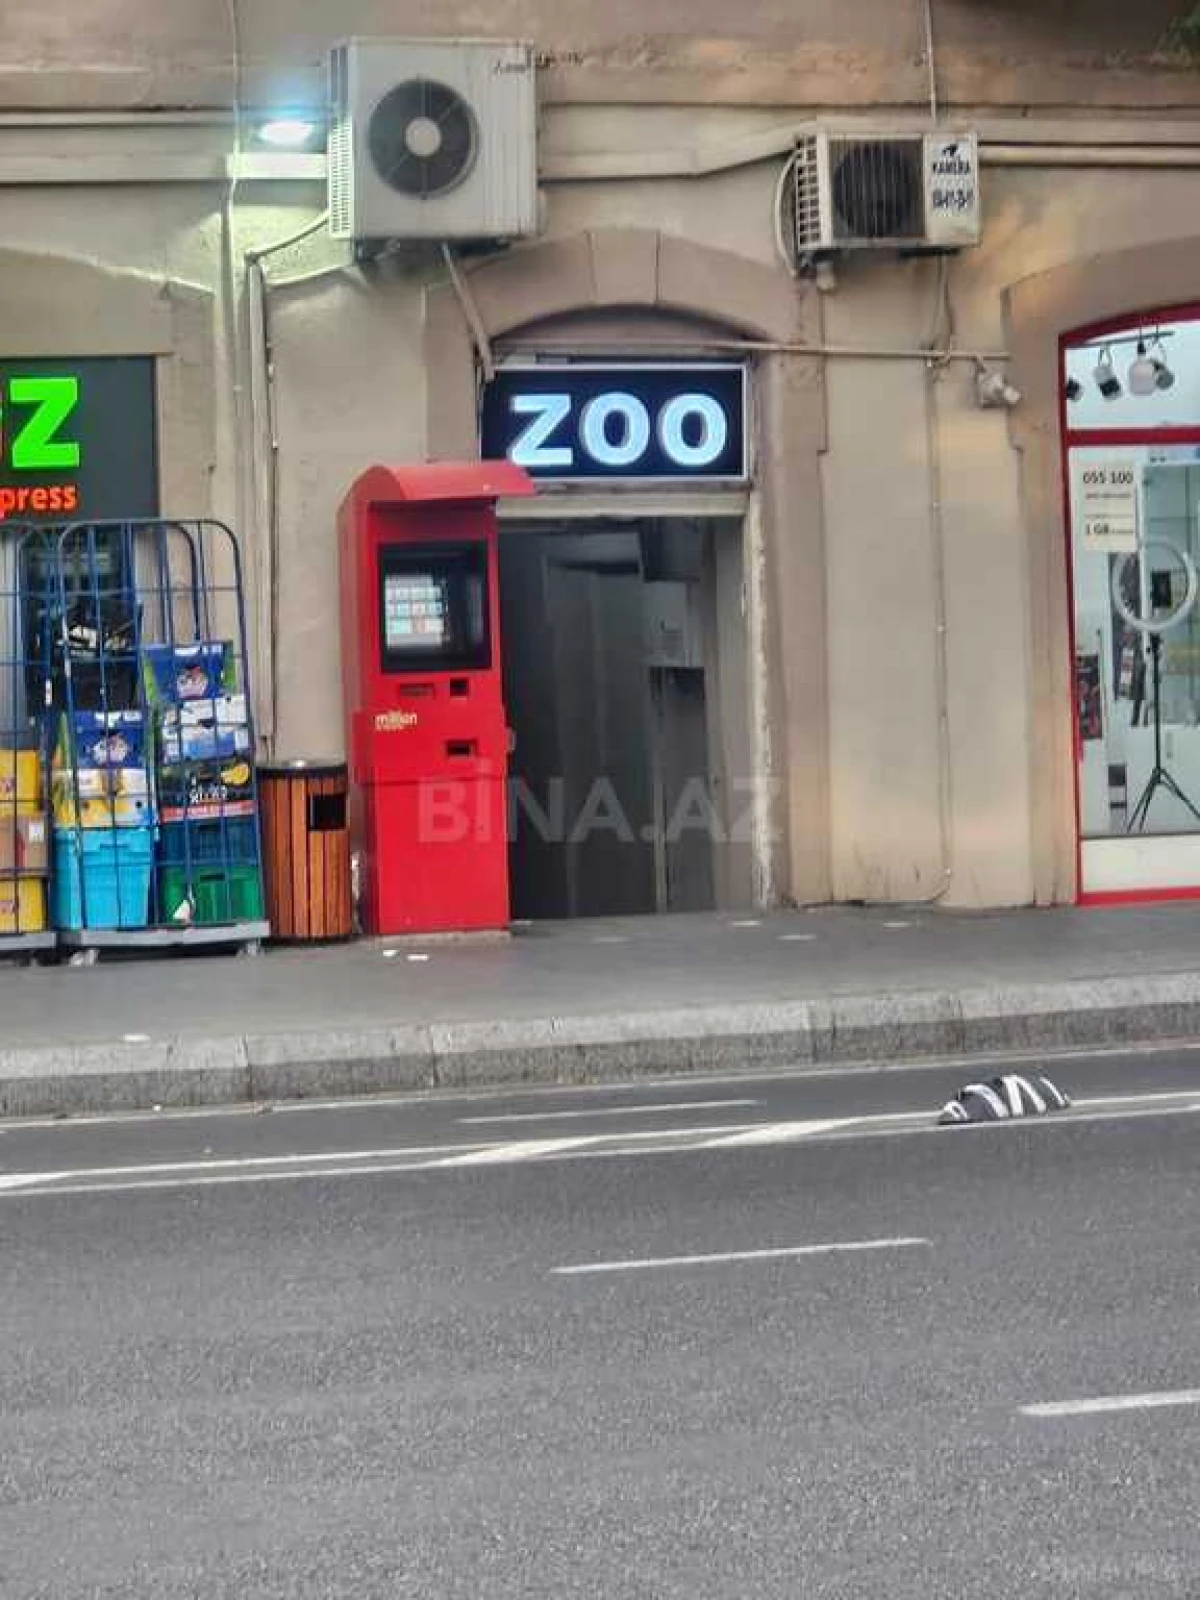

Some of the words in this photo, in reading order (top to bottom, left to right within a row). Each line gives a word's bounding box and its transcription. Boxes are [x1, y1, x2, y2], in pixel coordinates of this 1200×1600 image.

[508, 391, 728, 467] ZOO
[1083, 470, 1107, 484] 055
[1111, 470, 1134, 484] 100
